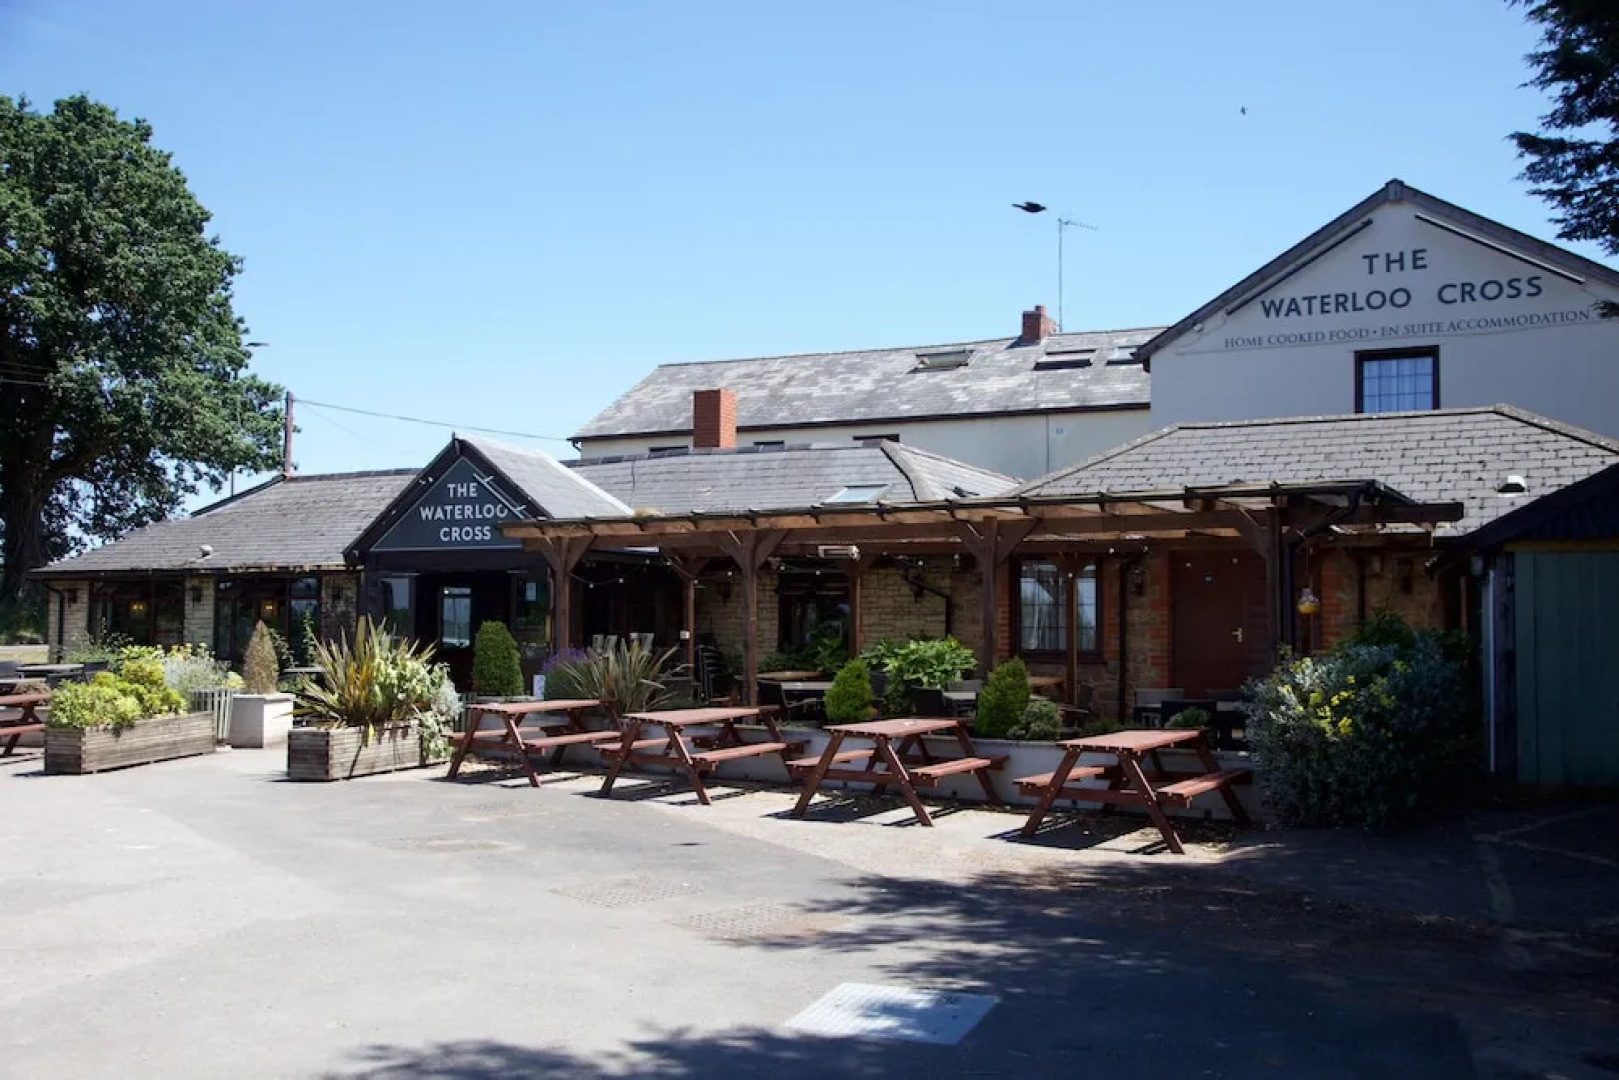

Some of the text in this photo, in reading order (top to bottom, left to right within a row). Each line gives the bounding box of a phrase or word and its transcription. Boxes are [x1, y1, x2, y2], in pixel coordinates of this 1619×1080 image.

[1362, 249, 1428, 274] THE
[1261, 276, 1543, 318] WATERLOO CROSS
[1225, 309, 1590, 348] HOME COOKED FOOD EN SUITE ACCOMMODATION
[447, 482, 478, 498] THE
[419, 503, 508, 521] WATERLOO
[439, 526, 491, 542] CROSS
